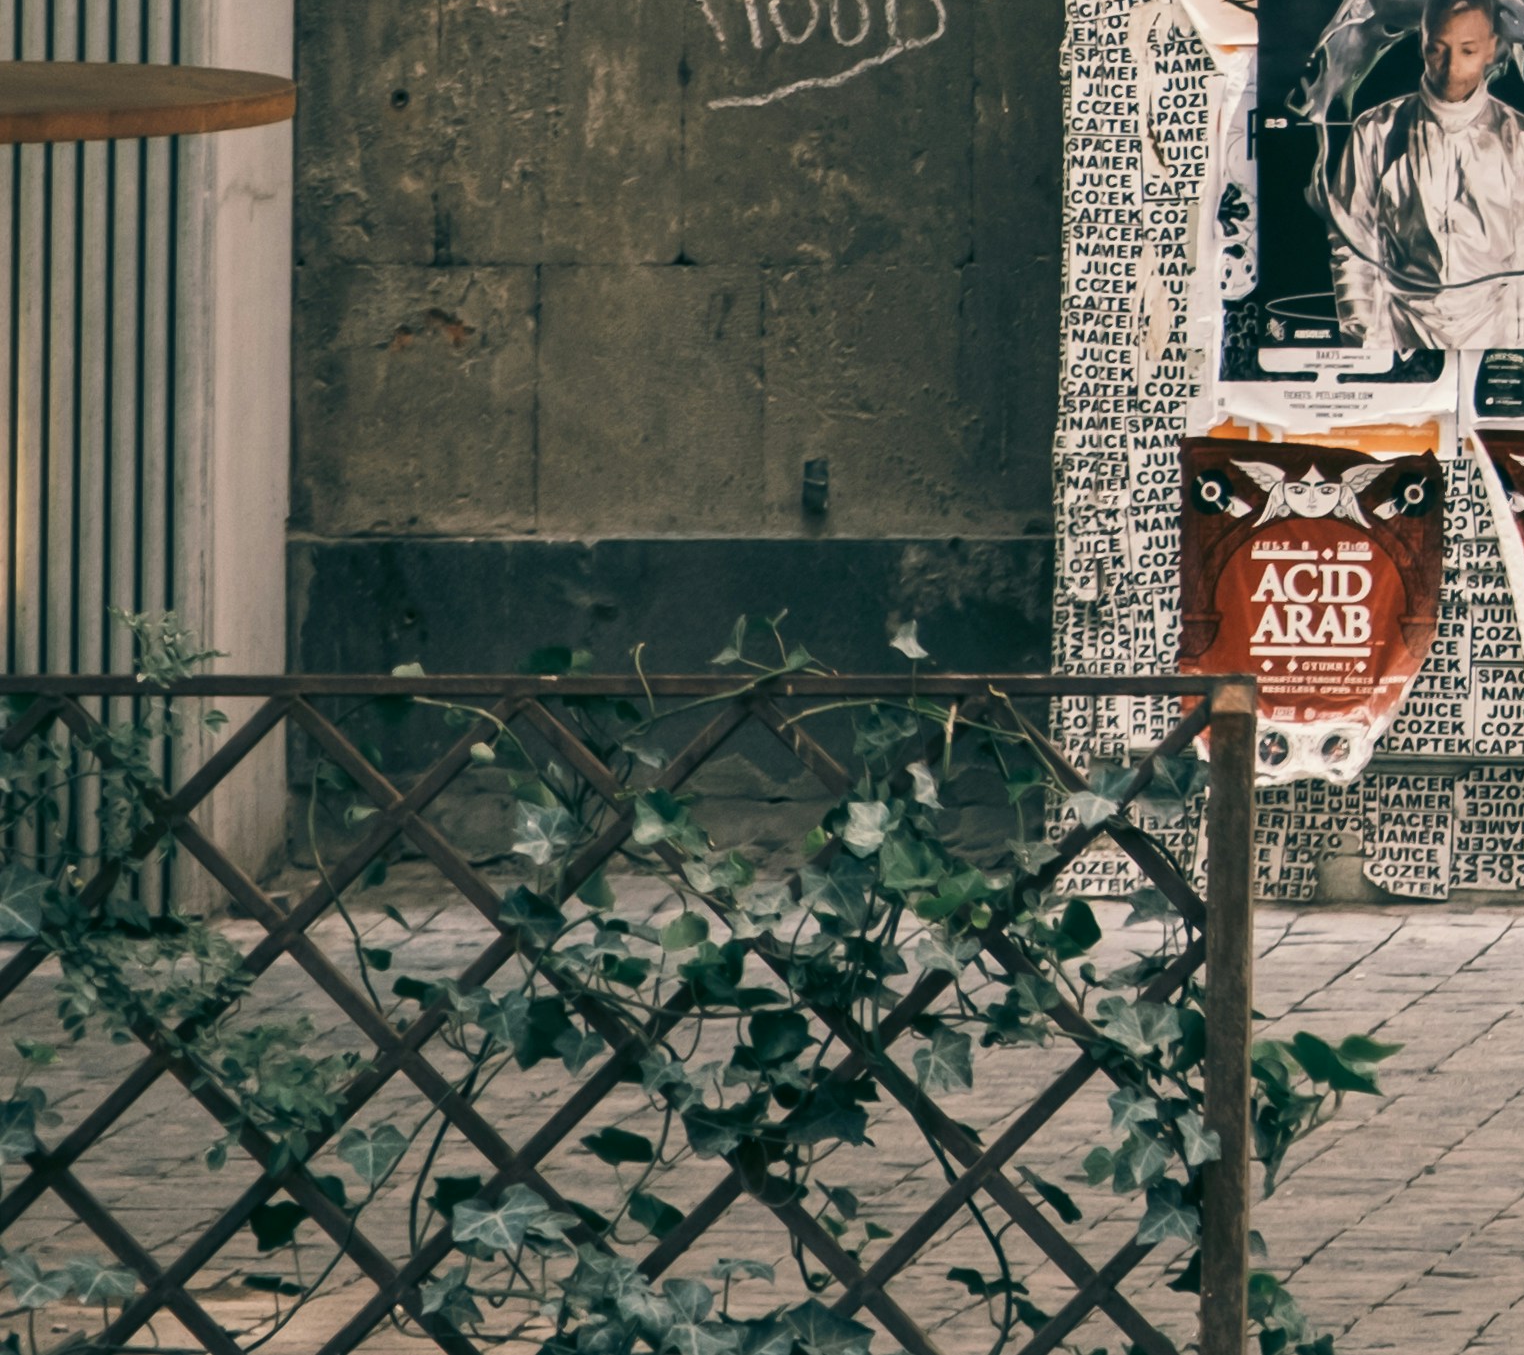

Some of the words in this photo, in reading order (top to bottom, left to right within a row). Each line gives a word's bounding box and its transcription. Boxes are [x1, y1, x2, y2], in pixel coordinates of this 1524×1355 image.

[1252, 541, 1290, 550] JULY
[1337, 542, 1369, 550] 23:00
[1251, 563, 1372, 603] ACID
[1250, 604, 1372, 644] ARAB
[1302, 662, 1351, 671] GYUMRI
